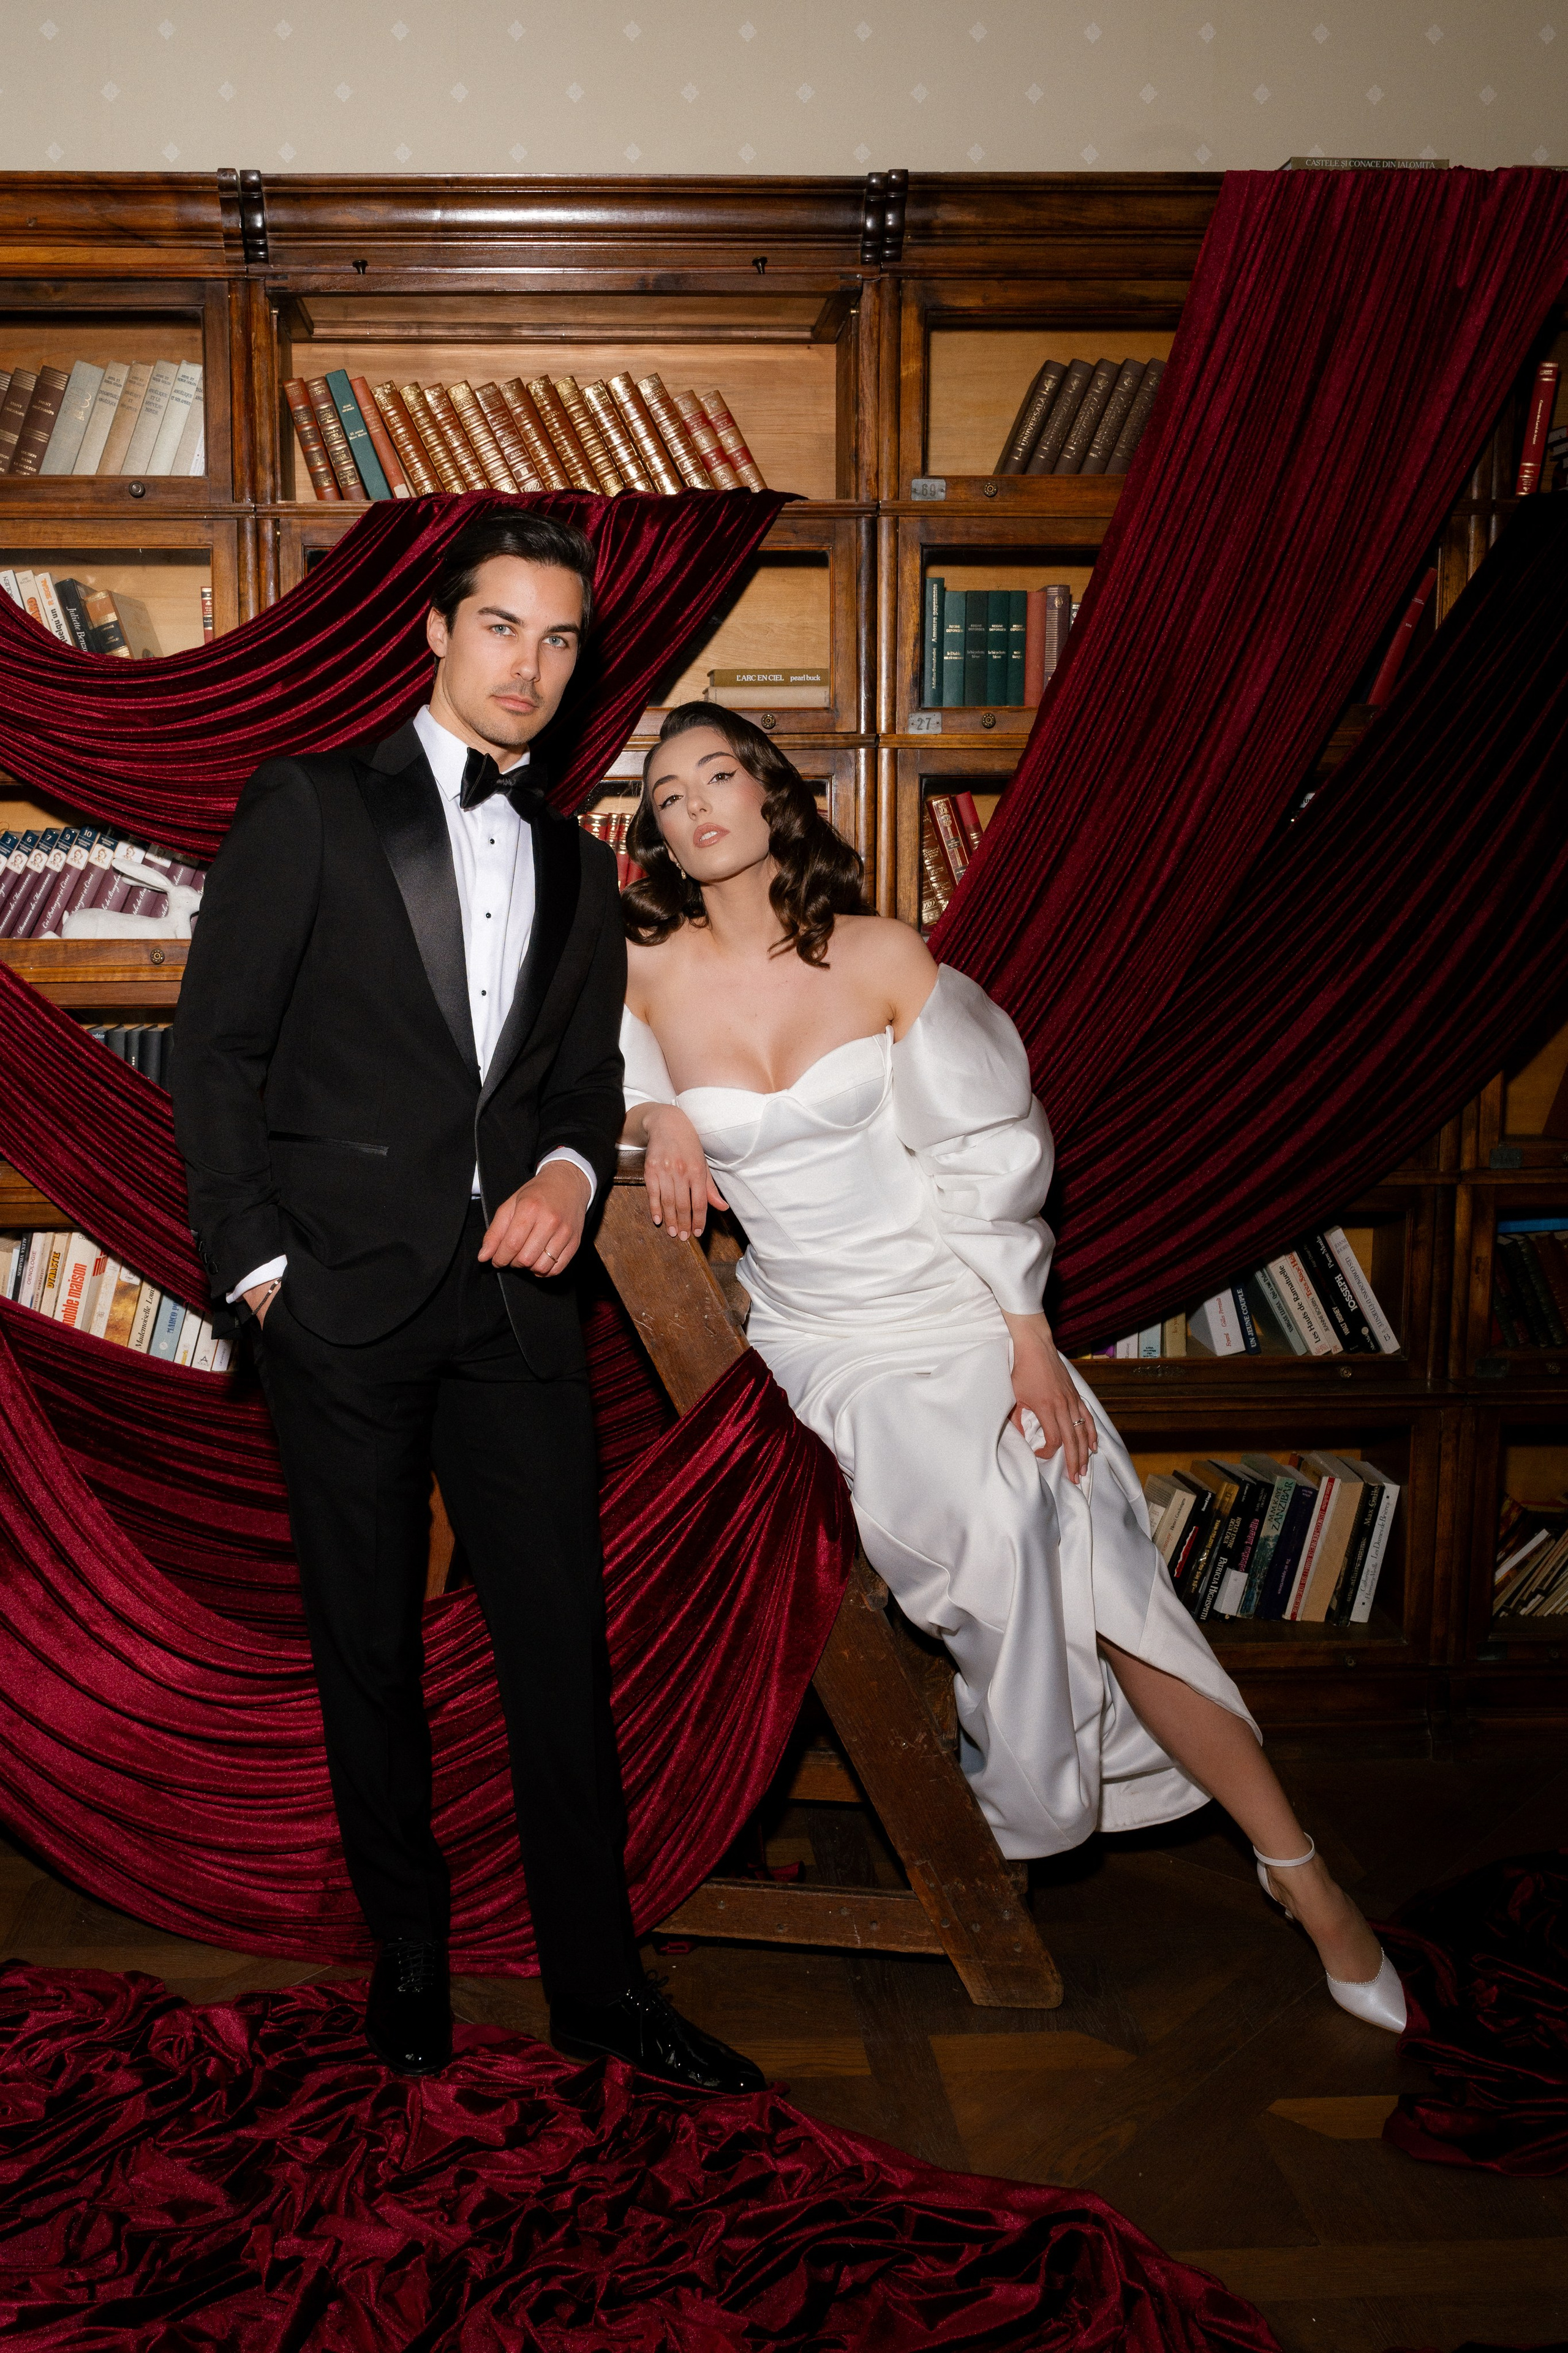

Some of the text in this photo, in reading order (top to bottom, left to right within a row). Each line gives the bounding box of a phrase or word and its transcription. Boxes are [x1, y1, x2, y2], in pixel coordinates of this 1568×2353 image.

[921, 484, 937, 497] 69
[66, 606, 88, 652] Juliette Benzo
[917, 718, 931, 730] 27
[61, 873, 70, 888] Cinci
[17, 910, 32, 935] Doamna
[27, 1250, 37, 1285] OENOLOGIE
[47, 1252, 61, 1289] DYNASTIE
[68, 1263, 87, 1299] maison
[1295, 1266, 1306, 1283] Sage
[1279, 1266, 1300, 1303] Ramatuelle
[1334, 1273, 1358, 1312] IOSSEPH
[1350, 1266, 1369, 1299] COMPAGNONS
[1237, 1288, 1257, 1348] UN JEUNE COUPLE
[1297, 1302, 1305, 1312] de
[1310, 1297, 1322, 1315] BOURIN
[135, 1305, 151, 1349] Mademoiselle
[167, 1311, 178, 1334] MARCO
[1302, 1312, 1315, 1332] Hauts
[1318, 1314, 1330, 1332] JEANNE
[1332, 1307, 1351, 1336] WALT DISNEY
[1272, 1481, 1294, 1532] ZANZIBAR
[1273, 1486, 1283, 1509] KAYE
[1364, 1509, 1374, 1526] Max
[1223, 1518, 1235, 1545] DEUX EAUX
[1227, 1516, 1242, 1549] RIPLEY ENTRE
[1374, 1533, 1383, 1551] Dames
[1211, 1556, 1228, 1585] PATRICIA
